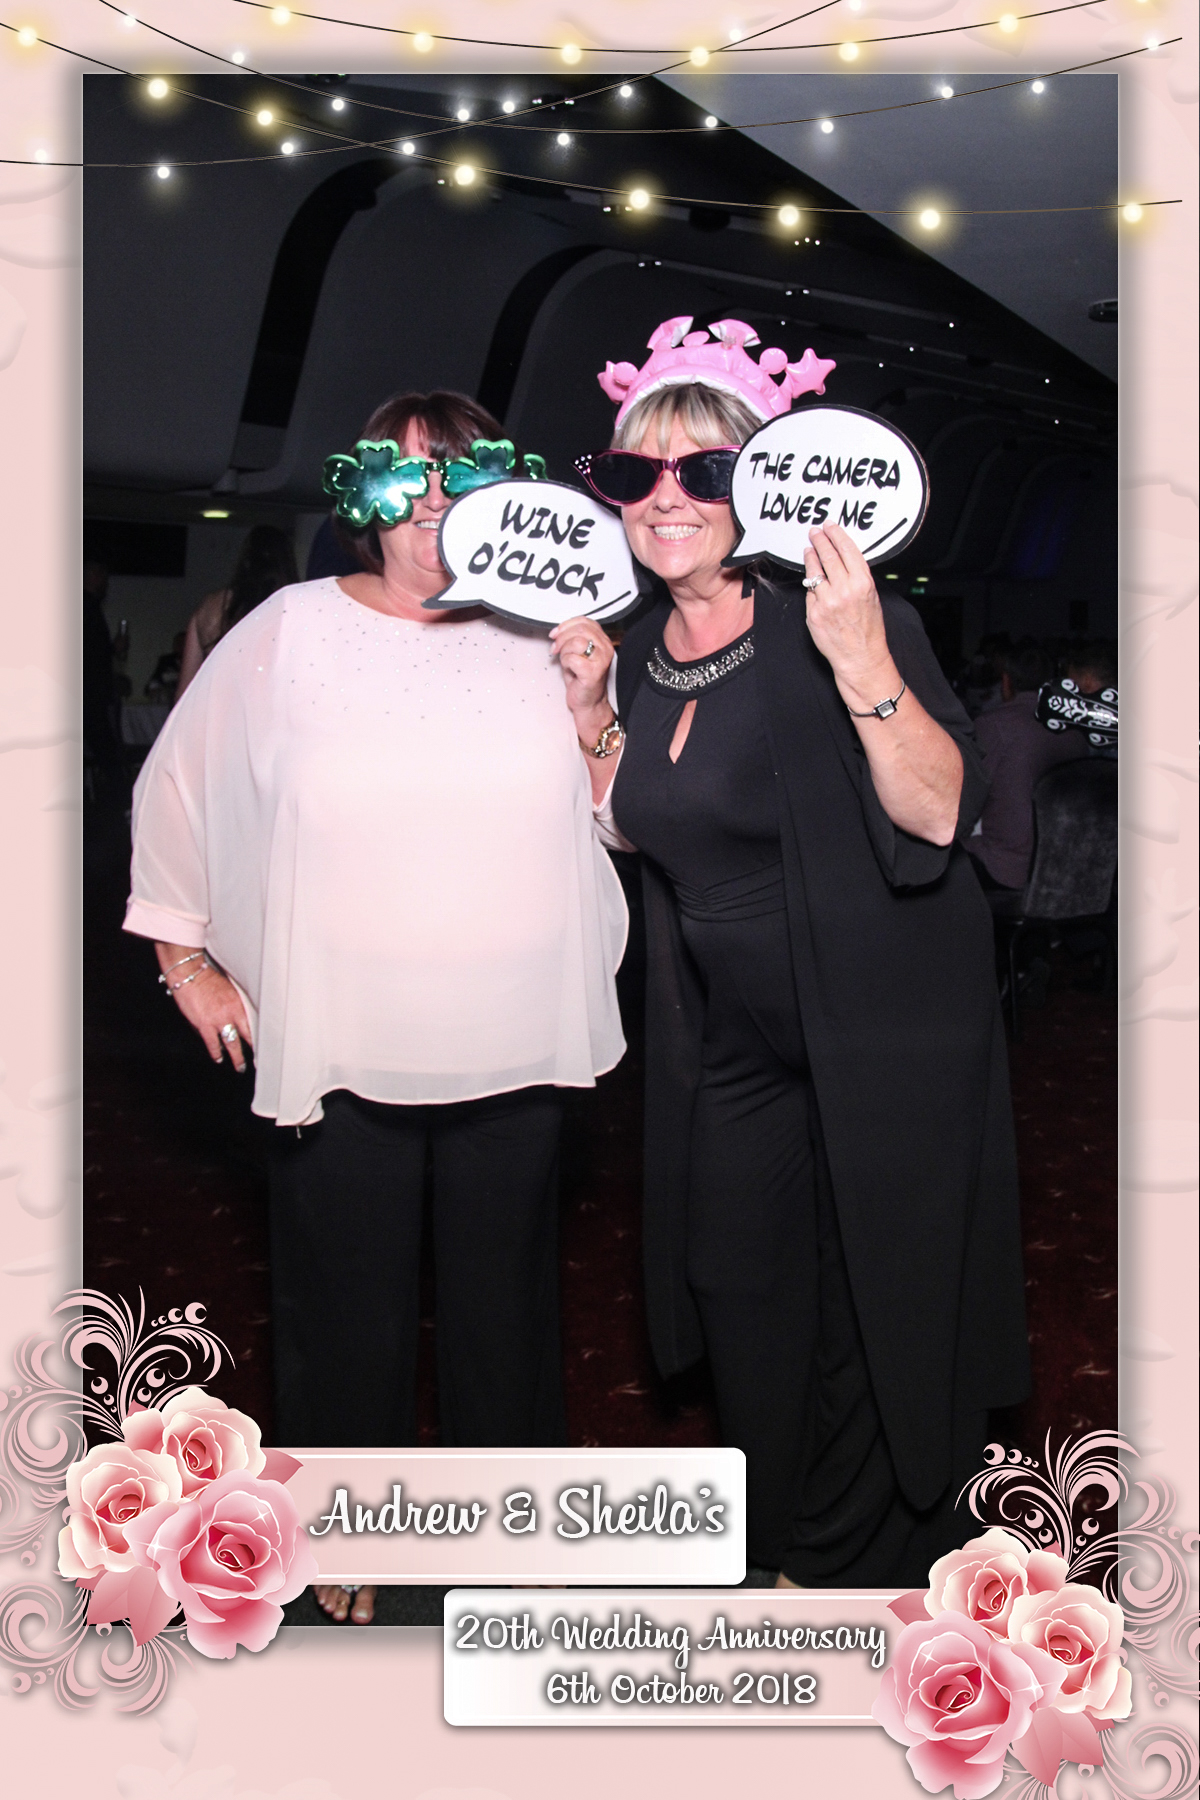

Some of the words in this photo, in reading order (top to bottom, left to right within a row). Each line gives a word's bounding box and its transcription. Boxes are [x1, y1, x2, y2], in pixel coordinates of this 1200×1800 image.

[750, 451, 795, 482] THE
[802, 454, 900, 491] CAMERA
[500, 499, 595, 549] WINE
[759, 492, 831, 525] LOVES
[838, 500, 877, 530] ME
[467, 540, 605, 601] O'CLOCK
